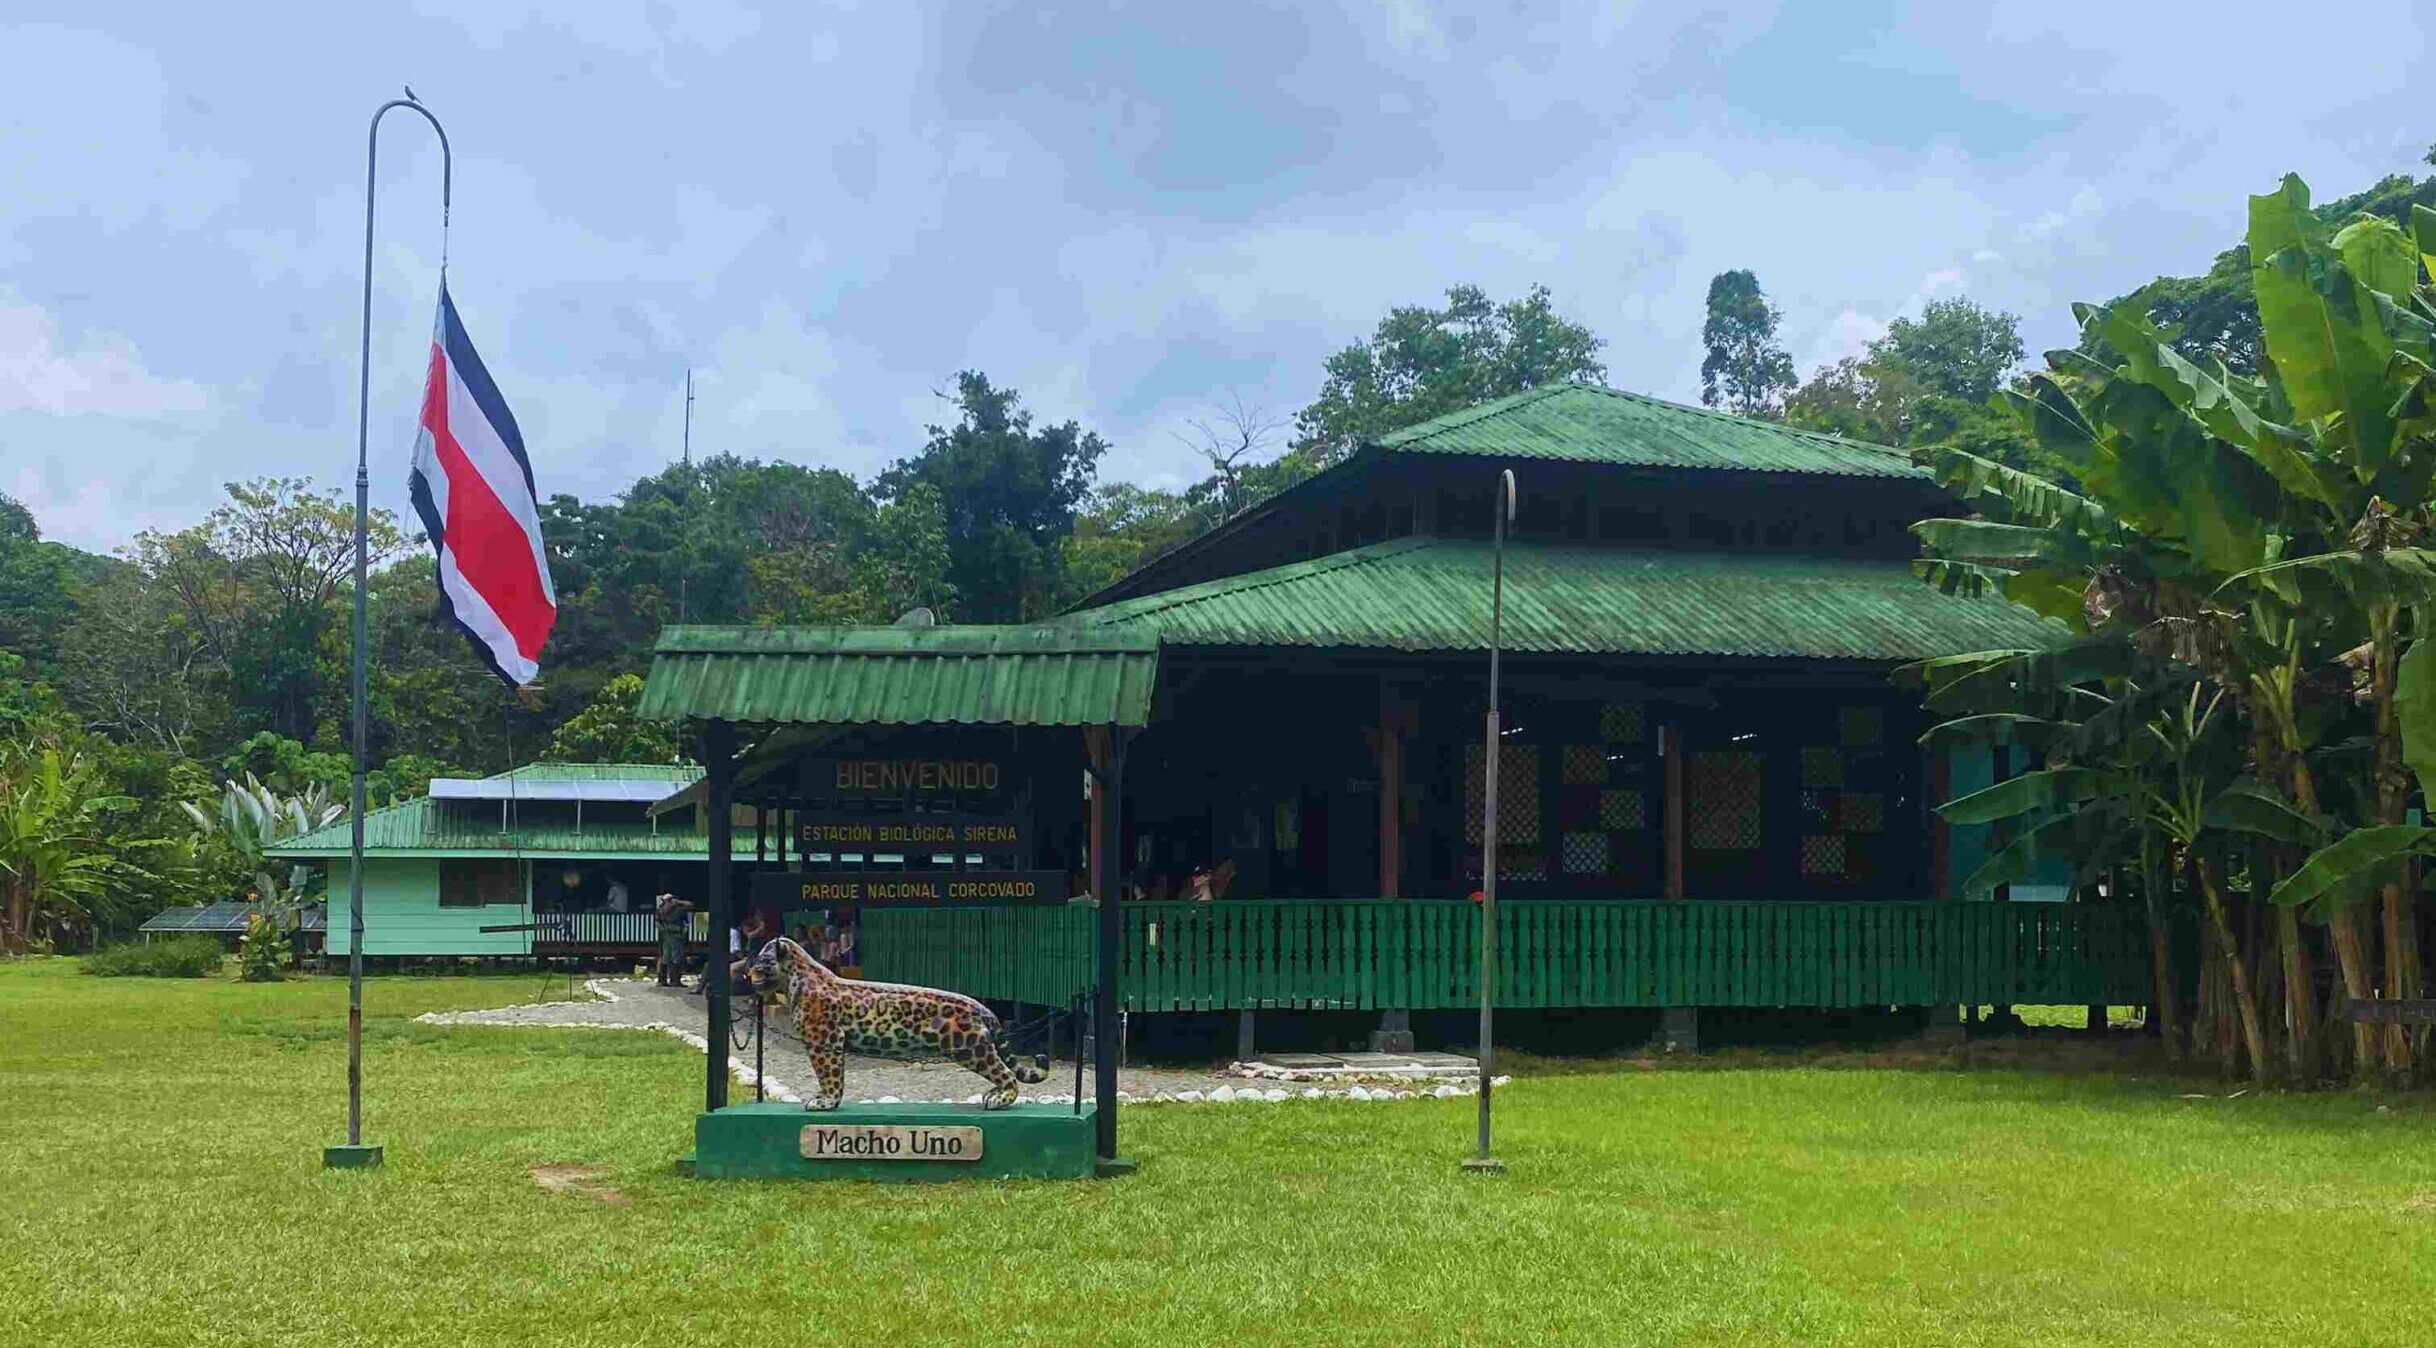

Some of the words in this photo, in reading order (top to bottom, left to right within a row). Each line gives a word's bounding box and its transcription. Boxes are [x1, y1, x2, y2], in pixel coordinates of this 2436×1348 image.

[836, 762, 998, 789] BIENVENIDO
[803, 825, 872, 841] ESTACIÓN
[880, 824, 955, 841] BIOLÓGICA
[965, 826, 1018, 841] SIRENA
[802, 884, 860, 899] PARQUE
[868, 883, 940, 899] NACIONAL
[949, 882, 1036, 898] CORCOVADO
[816, 1130, 900, 1154] Macho
[909, 1131, 963, 1155] Uno
